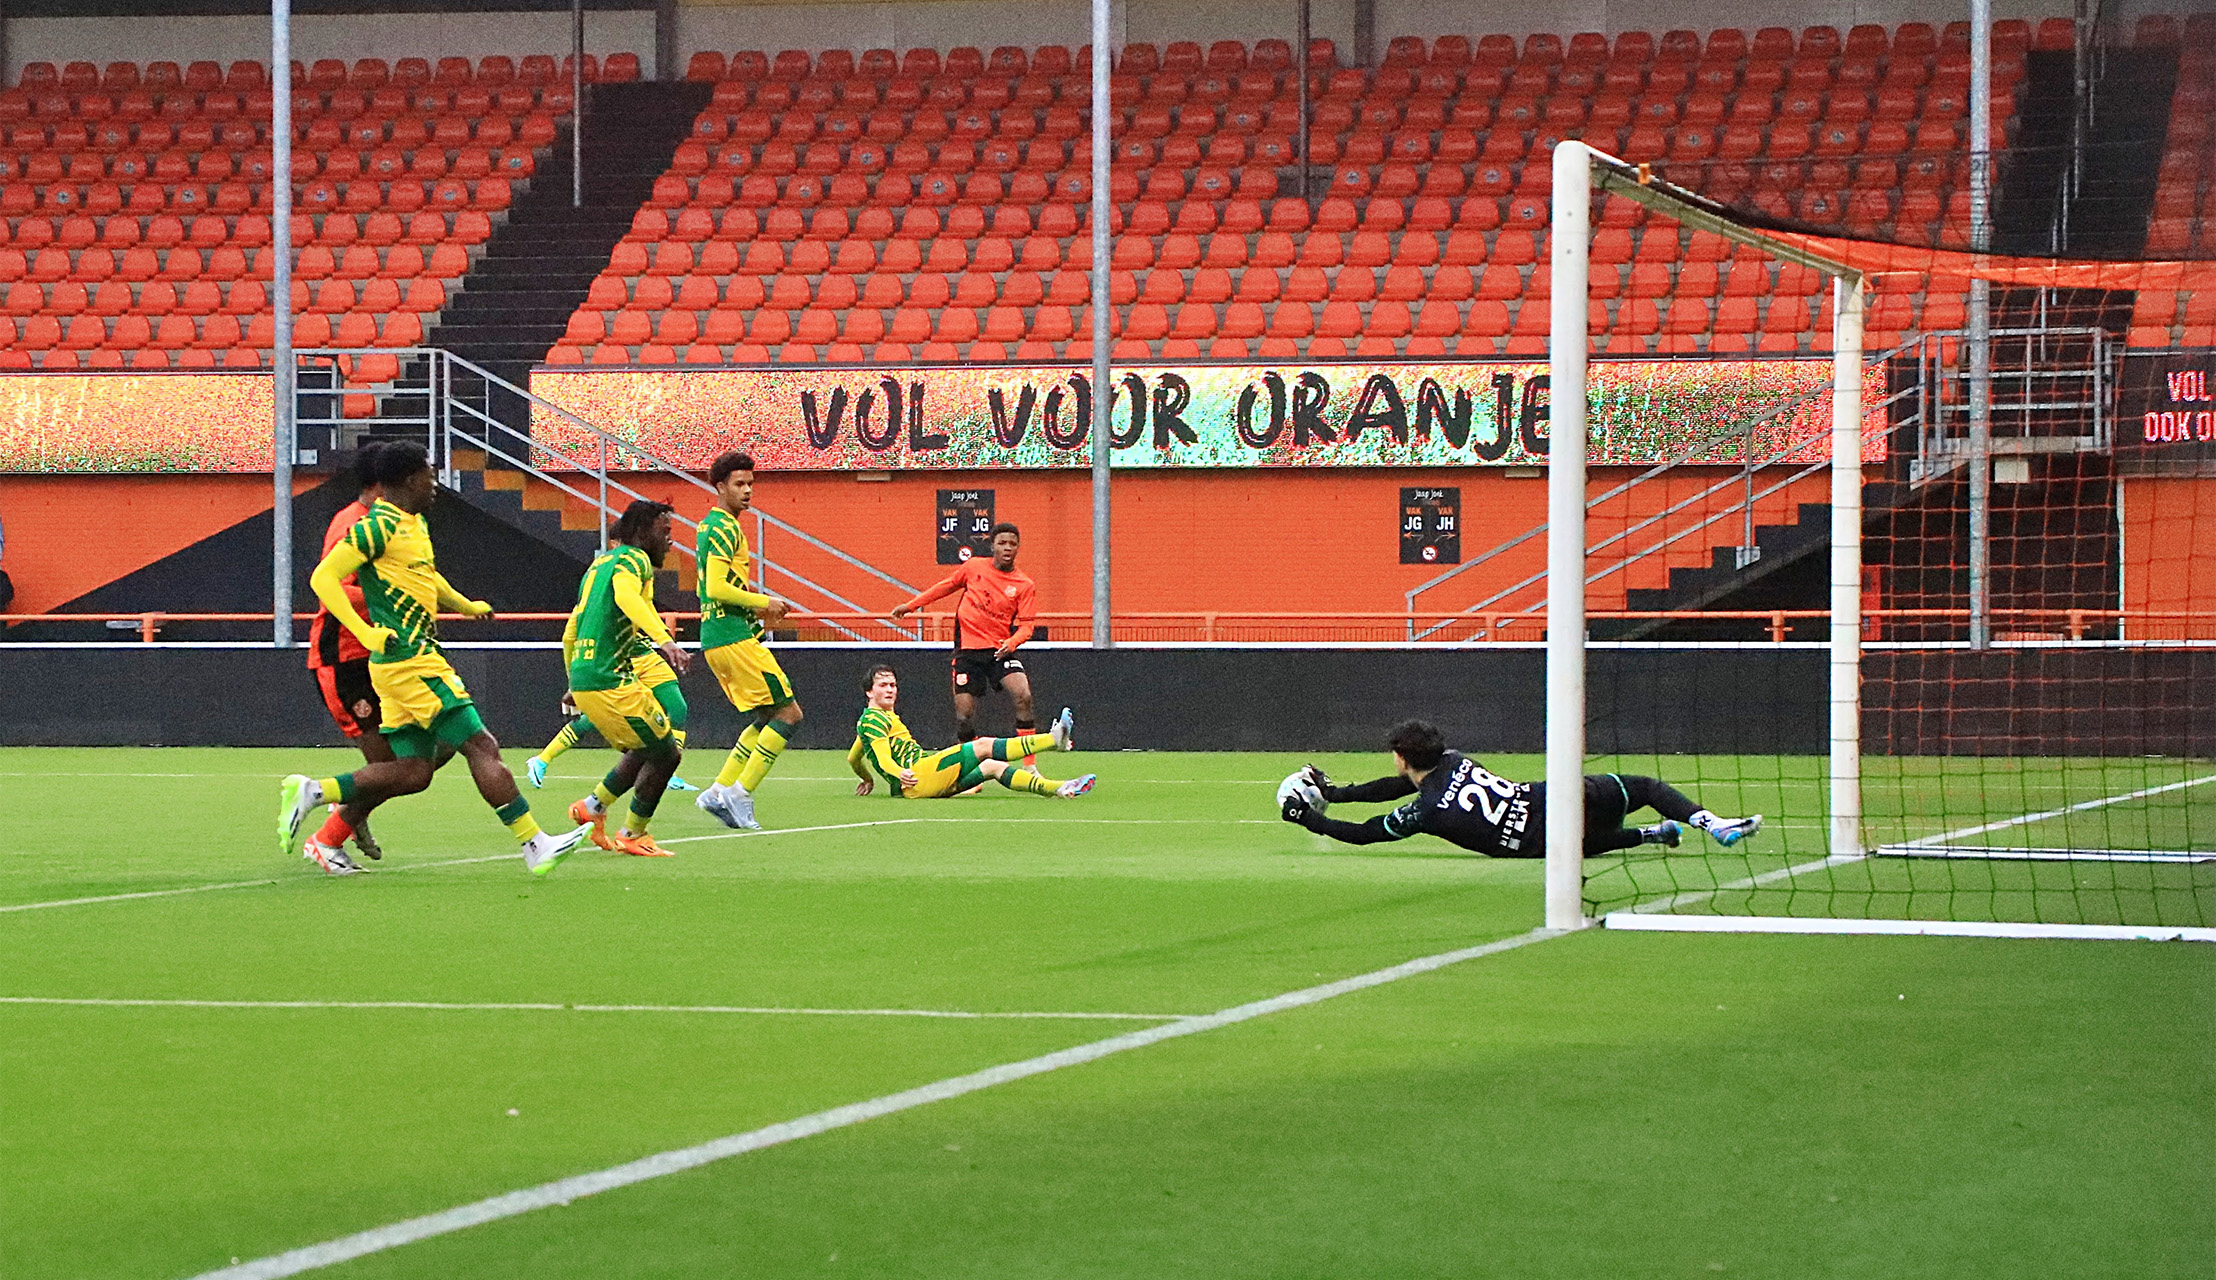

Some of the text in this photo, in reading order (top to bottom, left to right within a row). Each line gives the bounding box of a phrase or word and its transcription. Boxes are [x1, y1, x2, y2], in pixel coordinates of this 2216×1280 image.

[2166, 369, 2213, 402] VOL
[801, 370, 1551, 462] VOL VOOR ORANJE
[2144, 410, 2216, 442] OOK O
[943, 508, 957, 516] VAK
[973, 508, 988, 516] VAK
[1438, 506, 1453, 515] VAK
[942, 518, 958, 532] JF
[972, 518, 989, 532] JG
[1404, 516, 1422, 531] JG
[1436, 516, 1454, 531] JH
[1437, 758, 1473, 810] venéco
[1458, 766, 1516, 826] 28
